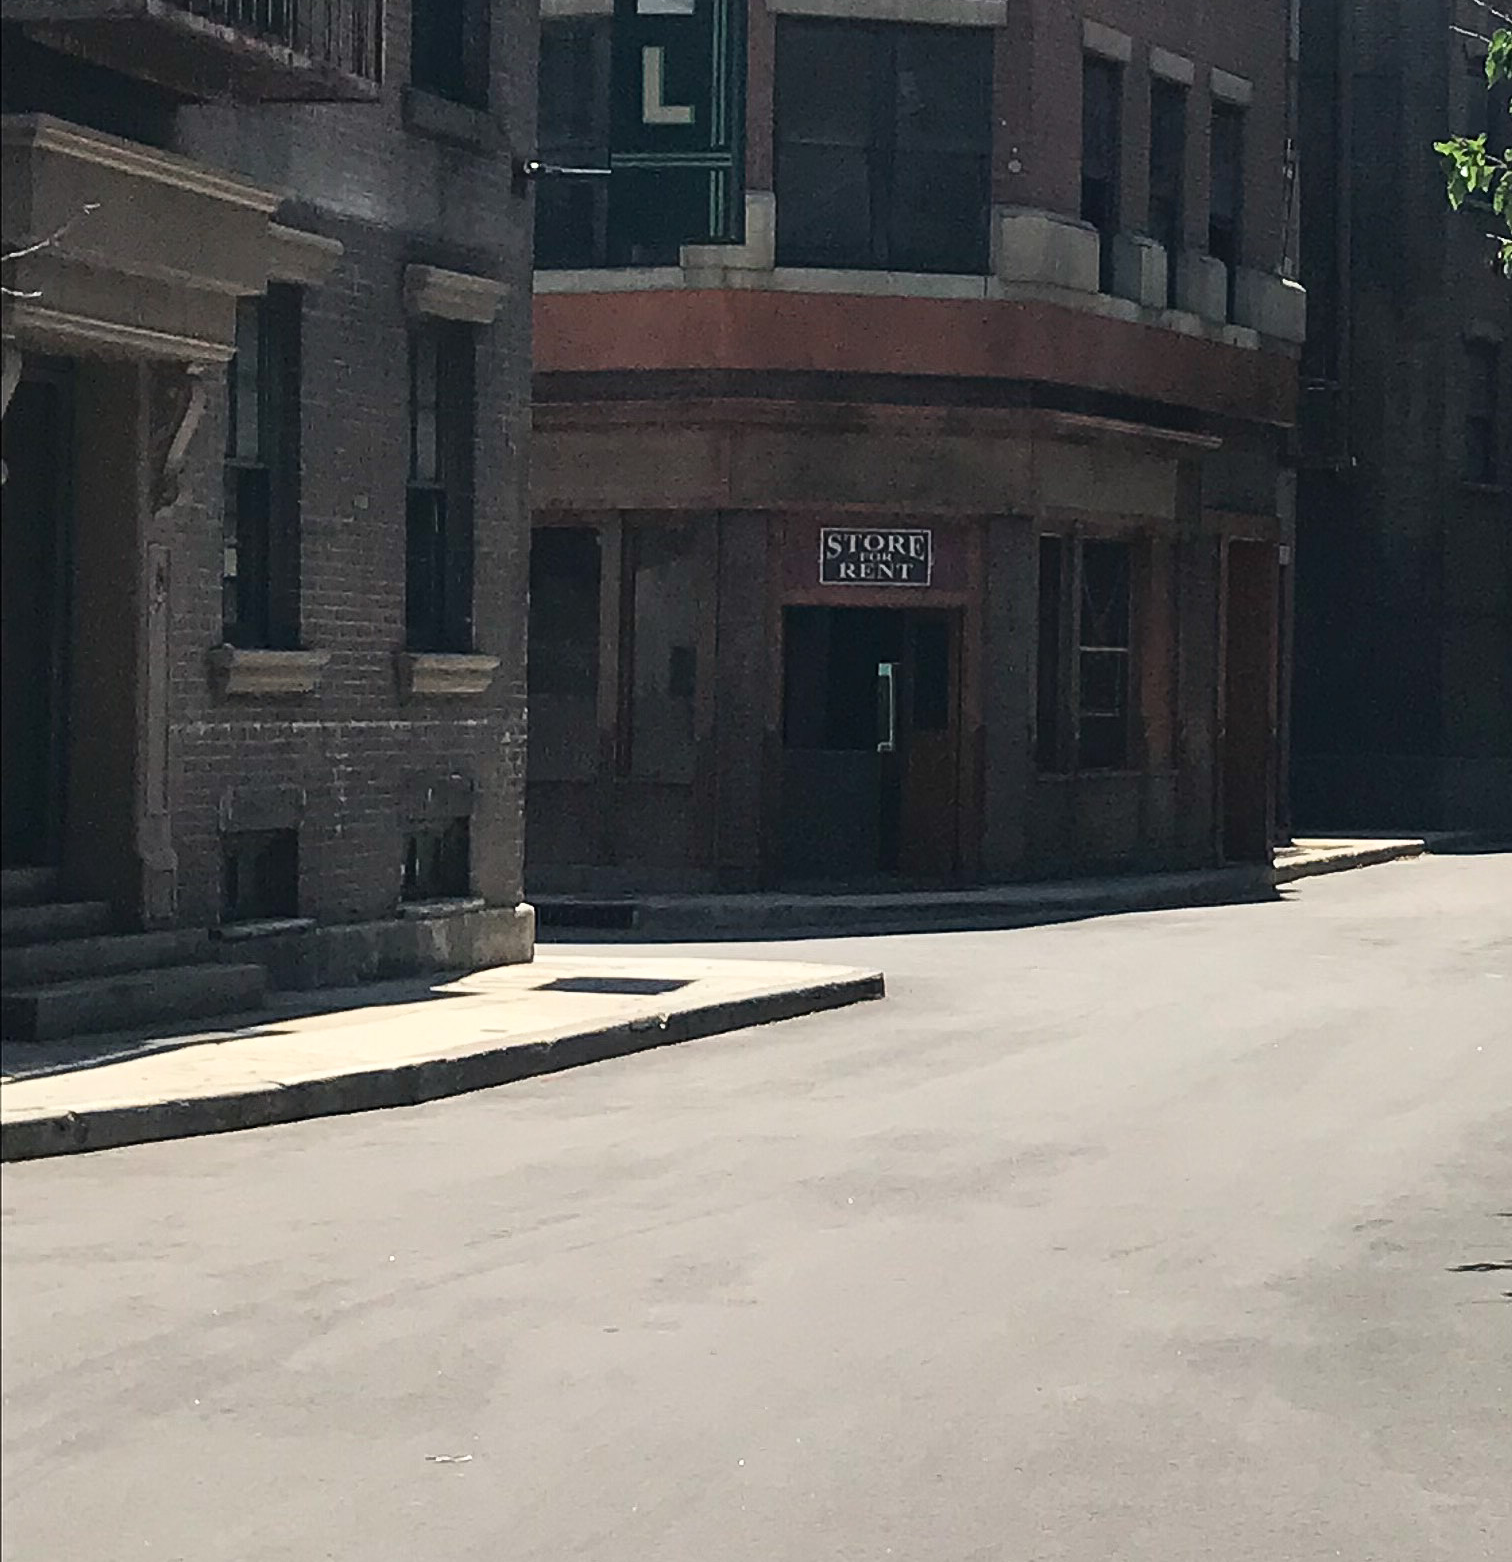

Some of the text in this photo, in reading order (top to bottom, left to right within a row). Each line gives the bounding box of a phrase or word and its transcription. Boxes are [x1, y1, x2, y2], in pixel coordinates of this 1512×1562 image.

[826, 532, 925, 562] STORE
[860, 551, 892, 562] FOR
[839, 561, 914, 580] RENT
